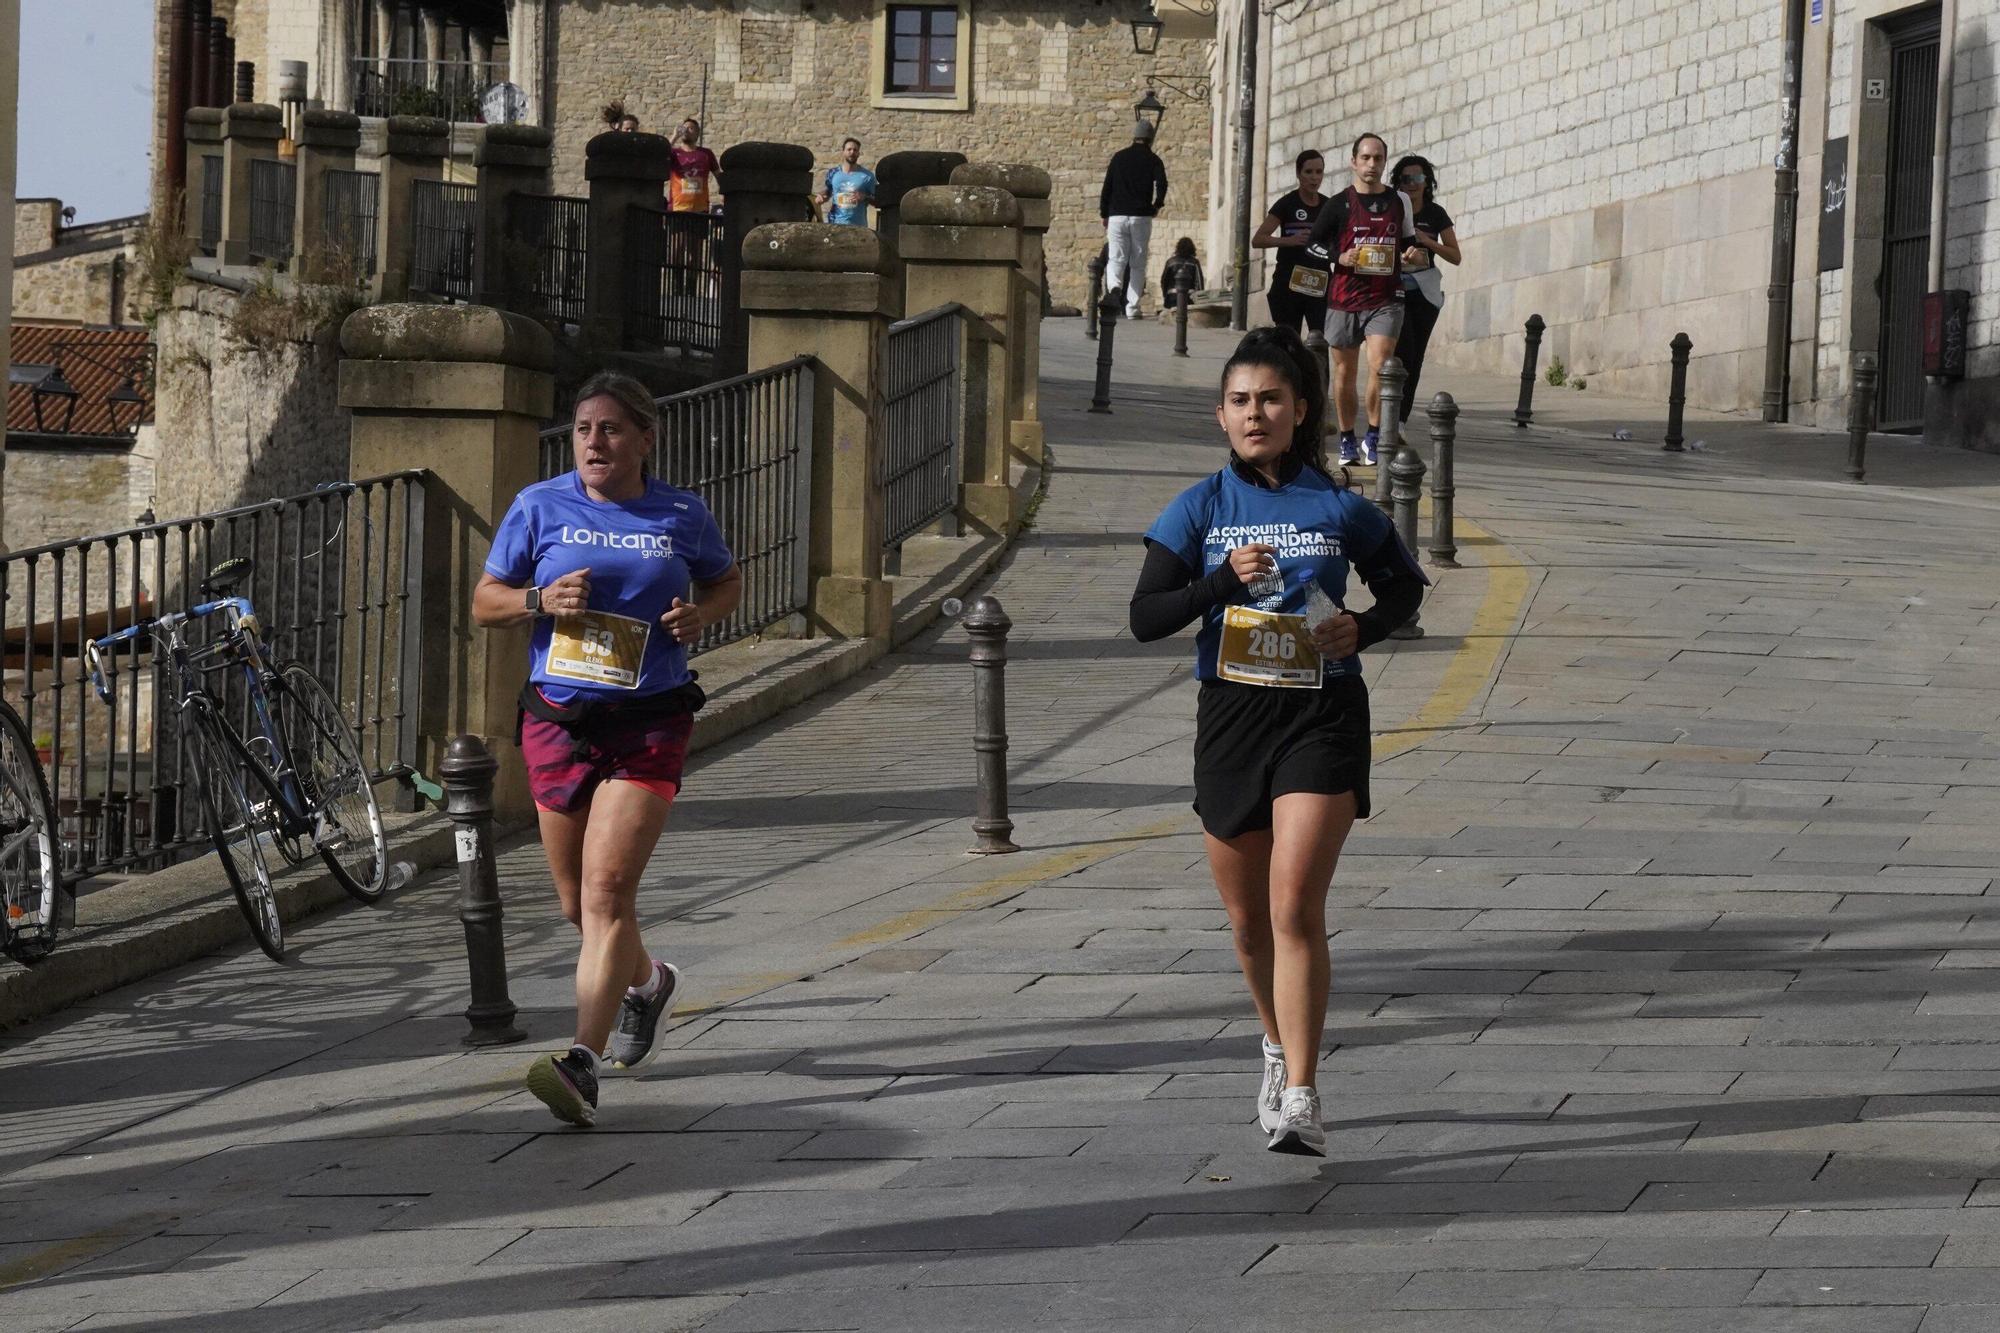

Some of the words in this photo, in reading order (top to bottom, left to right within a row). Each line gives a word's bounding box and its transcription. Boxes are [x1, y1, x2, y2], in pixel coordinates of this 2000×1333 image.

[1870, 82, 1881, 96] 5
[1368, 252, 1386, 264] 189
[1221, 523, 1298, 538] CONQUISTA
[1206, 537, 1215, 545] DE
[1216, 536, 1226, 544] LA
[1224, 532, 1327, 552] ALMENDRA
[641, 549, 674, 560] group
[1279, 545, 1342, 559] KONKISTA
[581, 627, 615, 657] 53
[1247, 628, 1296, 660] 286
